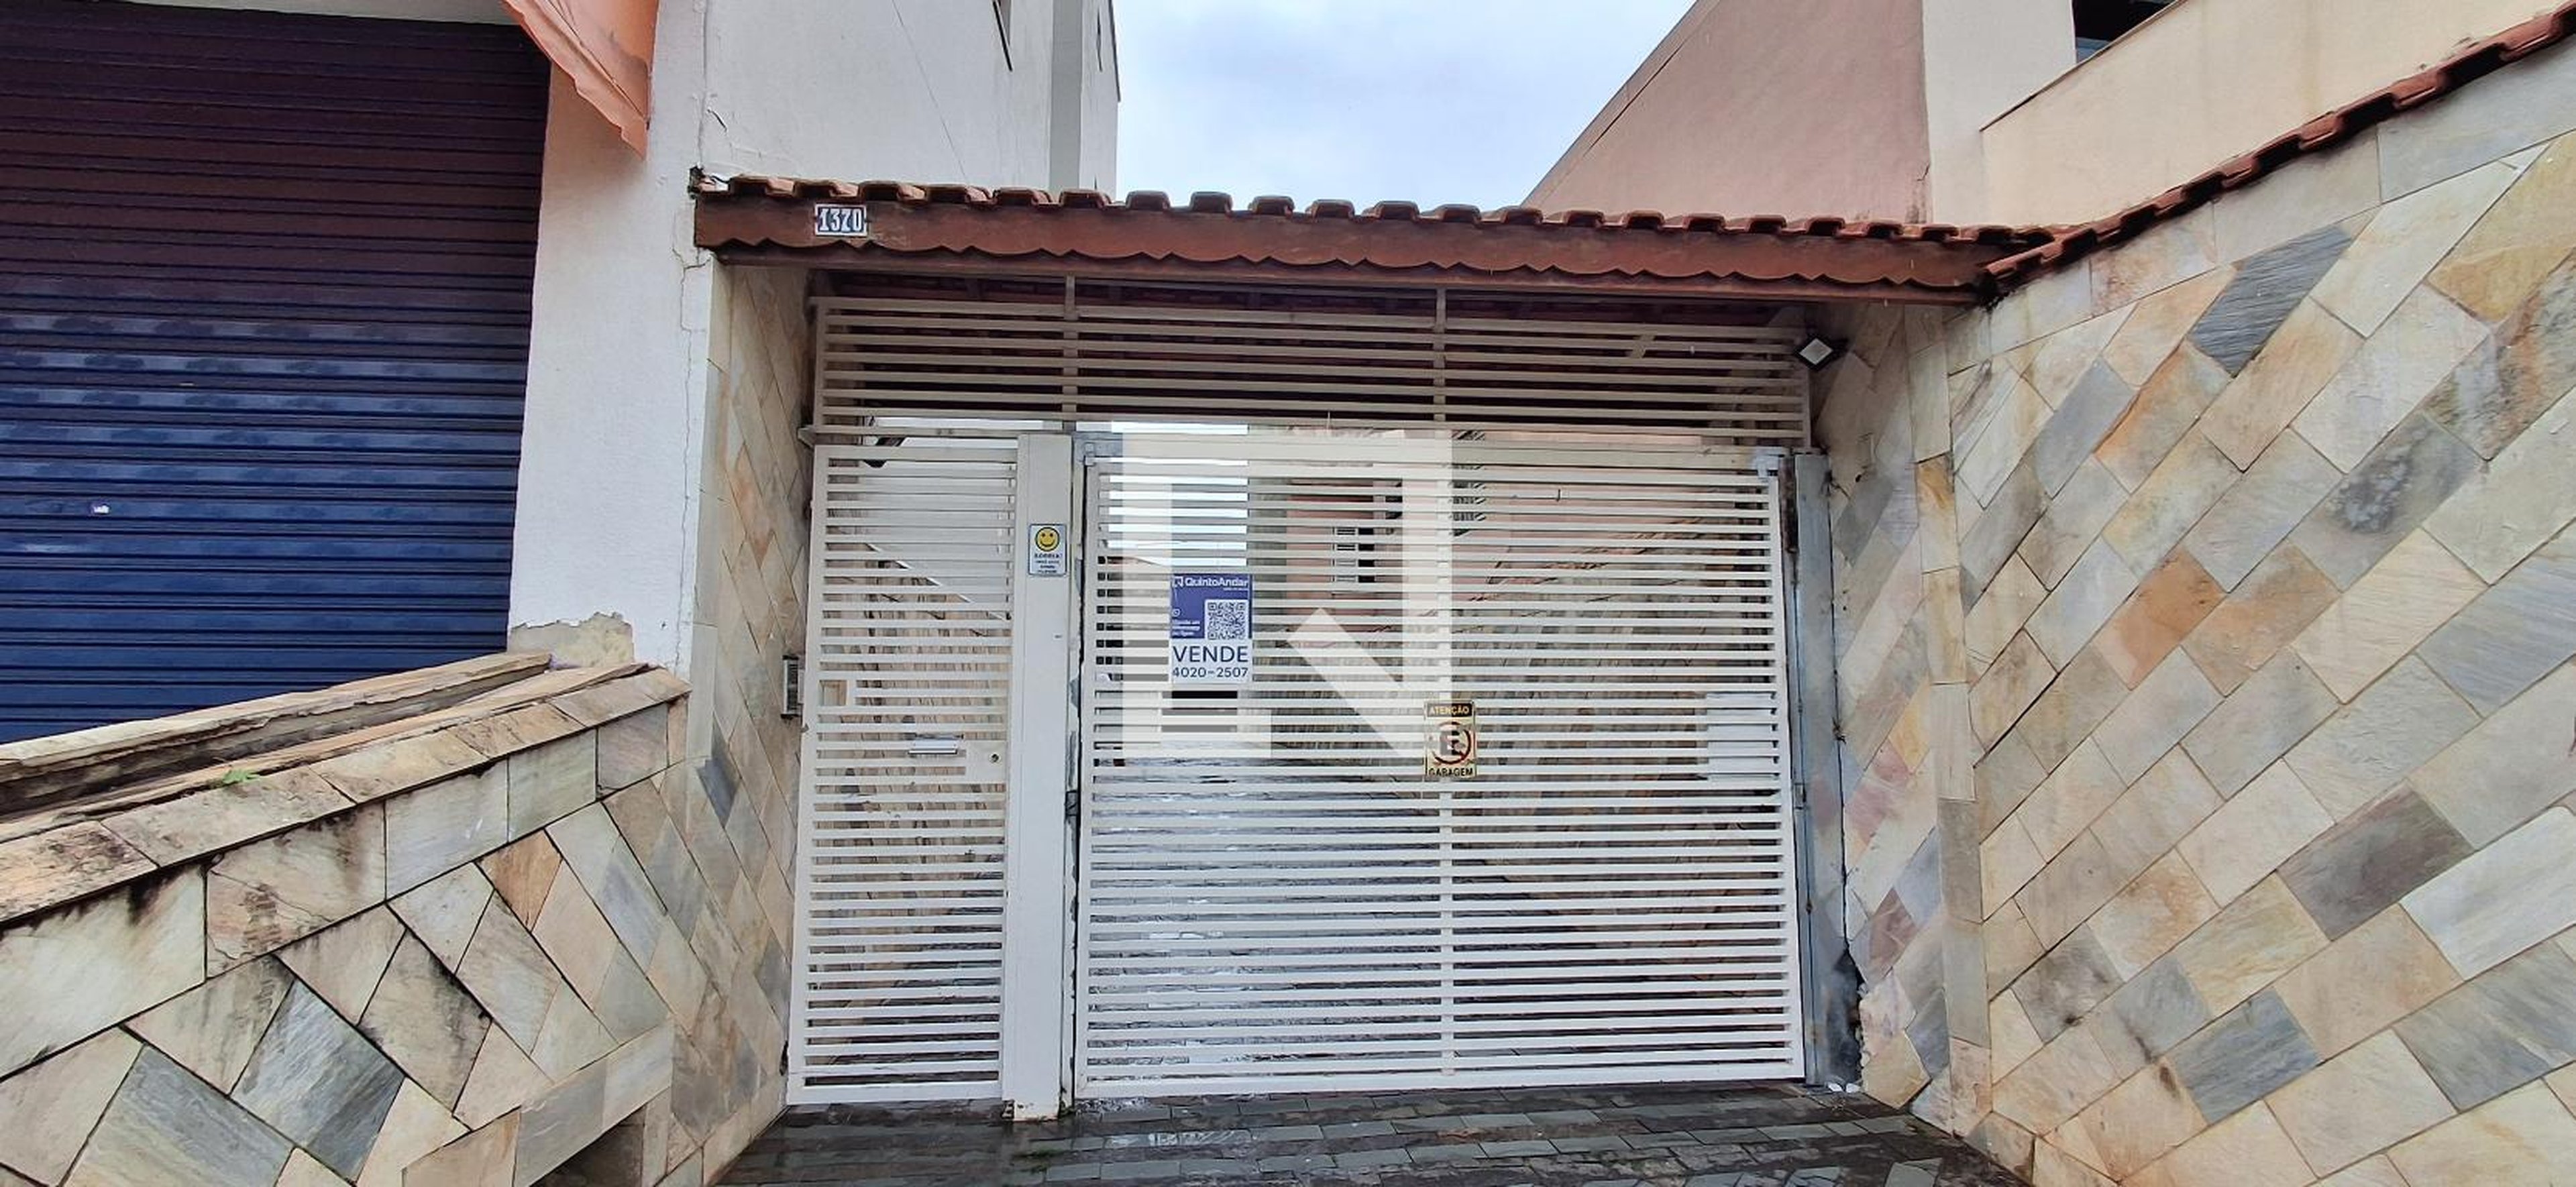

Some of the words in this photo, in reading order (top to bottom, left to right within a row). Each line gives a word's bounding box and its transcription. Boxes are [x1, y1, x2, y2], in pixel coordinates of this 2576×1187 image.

[819, 208, 862, 232] 1370
[1185, 577, 1248, 587] QuintoAndar
[1173, 645, 1249, 663] VENDE
[1173, 667, 1249, 678] 4020-2507
[1429, 704, 1470, 716] ATENÇÃO
[1428, 767, 1473, 777] GARAGEM
